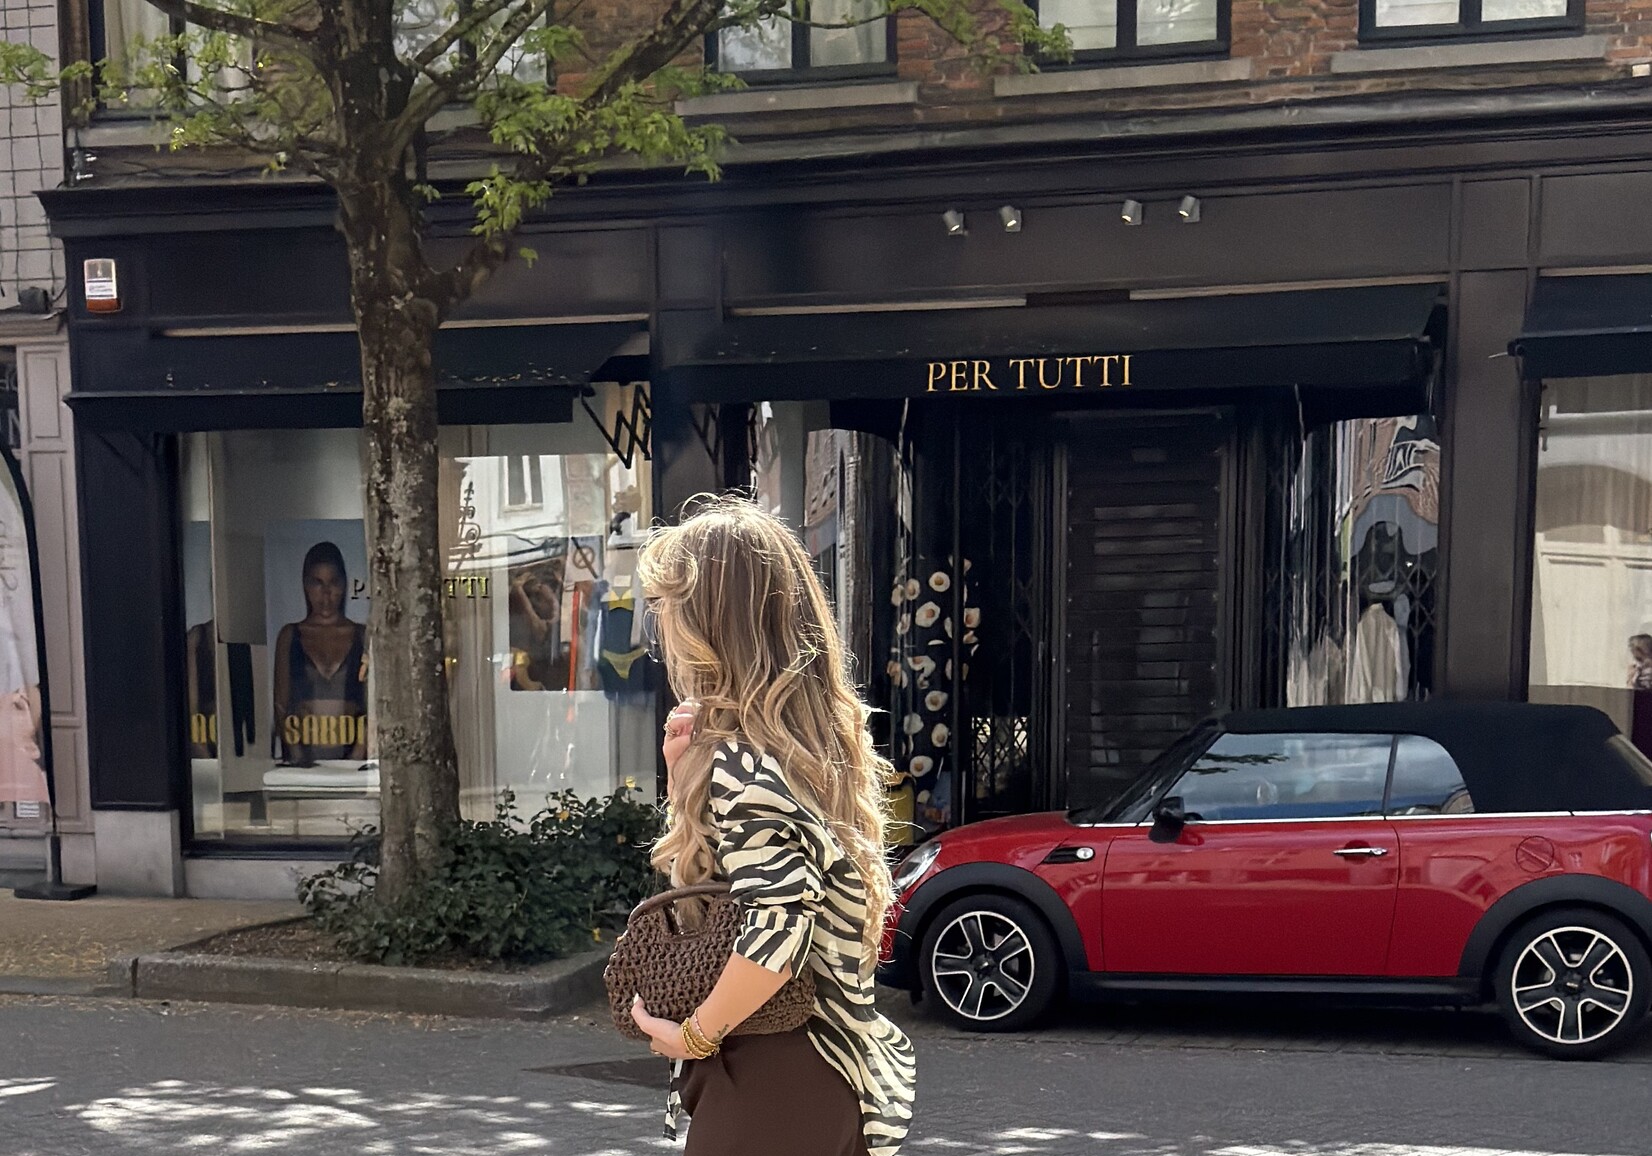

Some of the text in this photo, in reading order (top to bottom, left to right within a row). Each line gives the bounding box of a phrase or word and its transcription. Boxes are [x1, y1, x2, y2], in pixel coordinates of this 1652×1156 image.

[926, 355, 1134, 391] PER TUTTI
[444, 576, 489, 599] TTI
